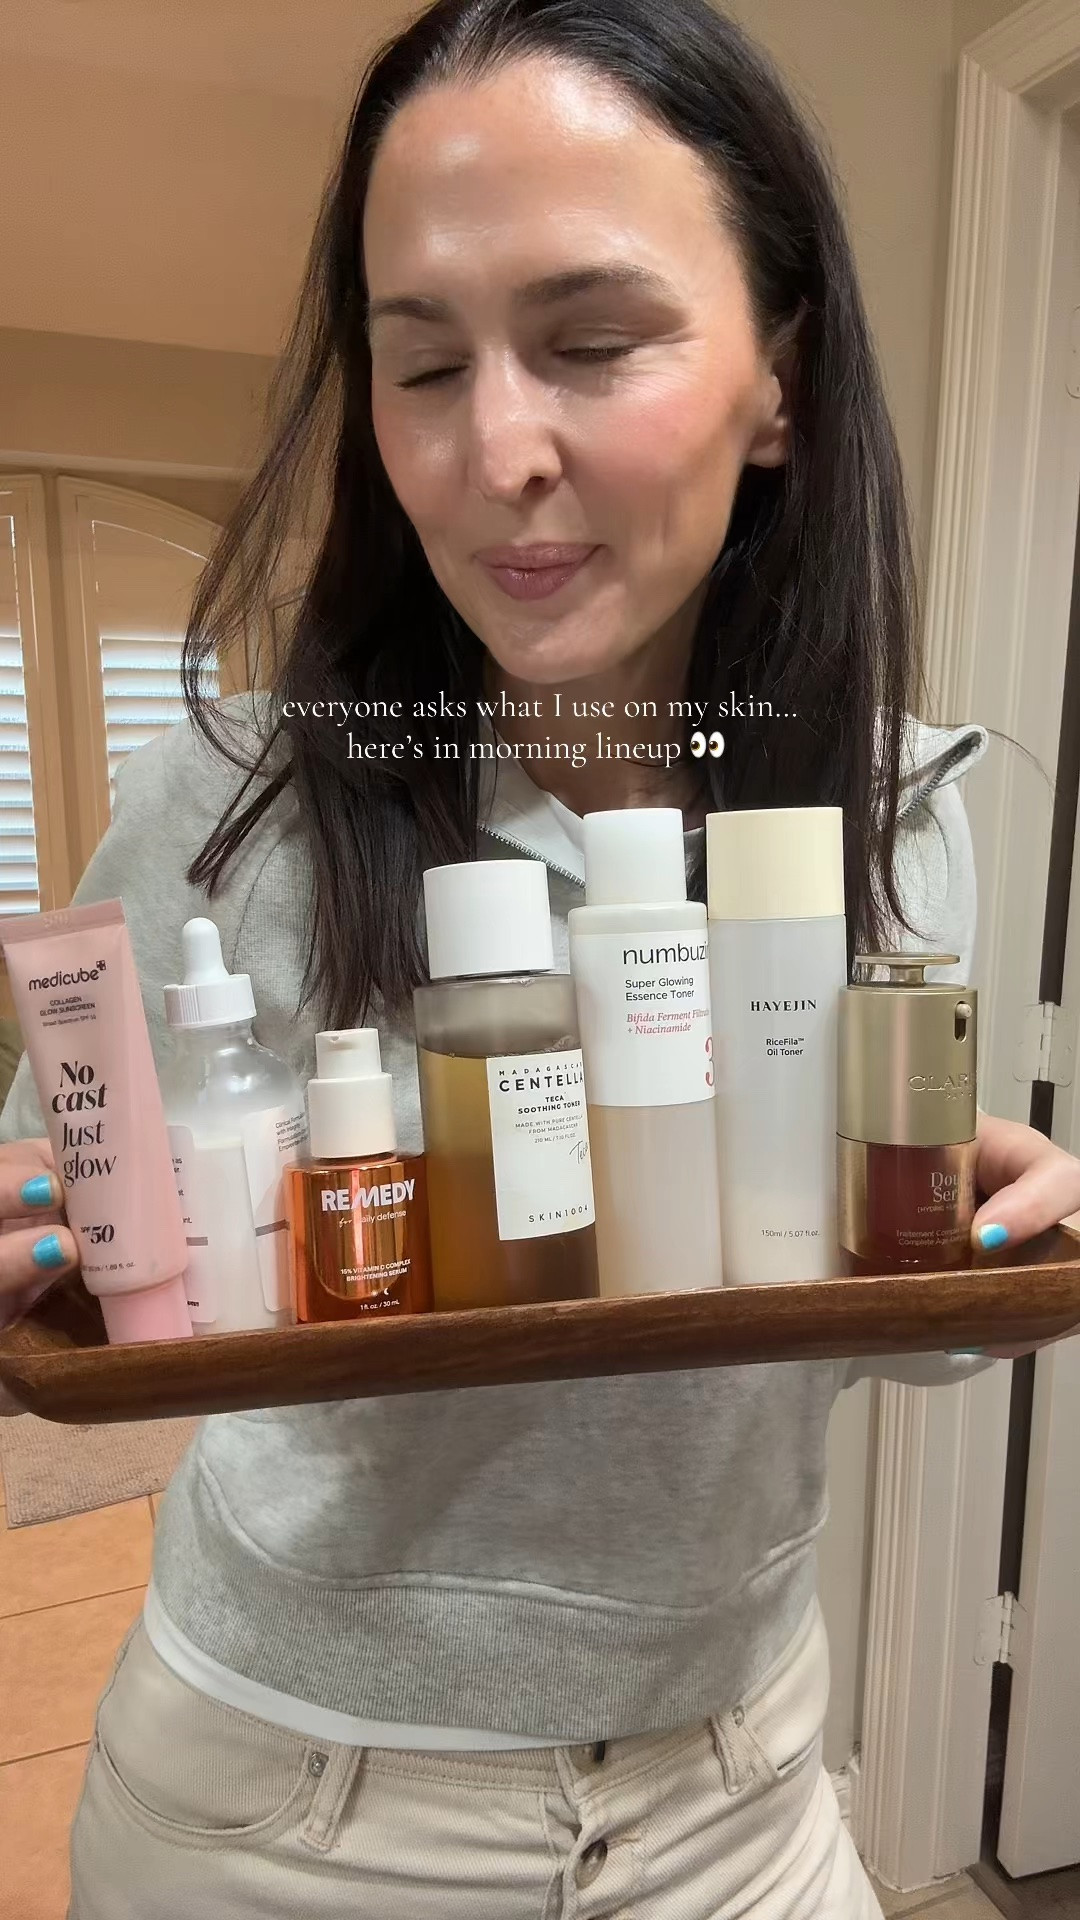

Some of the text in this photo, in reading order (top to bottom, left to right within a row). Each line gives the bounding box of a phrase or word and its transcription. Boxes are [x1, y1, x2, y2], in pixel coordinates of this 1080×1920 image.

[28, 968, 100, 990] medicube
[625, 976, 694, 990] Super Glowing
[50, 996, 82, 1006] COLLAGEN
[626, 989, 695, 1001] Essence Toner
[40, 1003, 96, 1016] GLOW SUNSCREEN
[750, 999, 817, 1012] HAYEJIN
[626, 1012, 655, 1023] Bifida
[657, 1011, 691, 1022] Ferment
[635, 1022, 691, 1035] Niacinamide
[767, 1048, 804, 1056] Oil Toner
[60, 1060, 94, 1088] No
[499, 1071, 584, 1092] CENTELLA
[51, 1083, 108, 1114] cast
[545, 1095, 564, 1103] TECA
[518, 1100, 580, 1114] SOOTHING TONER
[62, 1119, 106, 1151] Just
[63, 1152, 117, 1188] glow
[321, 1178, 415, 1211] REMEDY
[339, 1210, 407, 1228] for aily defense
[528, 1204, 588, 1223] SKIN1004
[90, 1224, 115, 1244] 50
[761, 1229, 782, 1237] 150ml
[353, 1265, 380, 1274] VITAMIN
[386, 1258, 411, 1269] COMPLEX
[346, 1267, 408, 1282] BRIGHTENING SERUM
